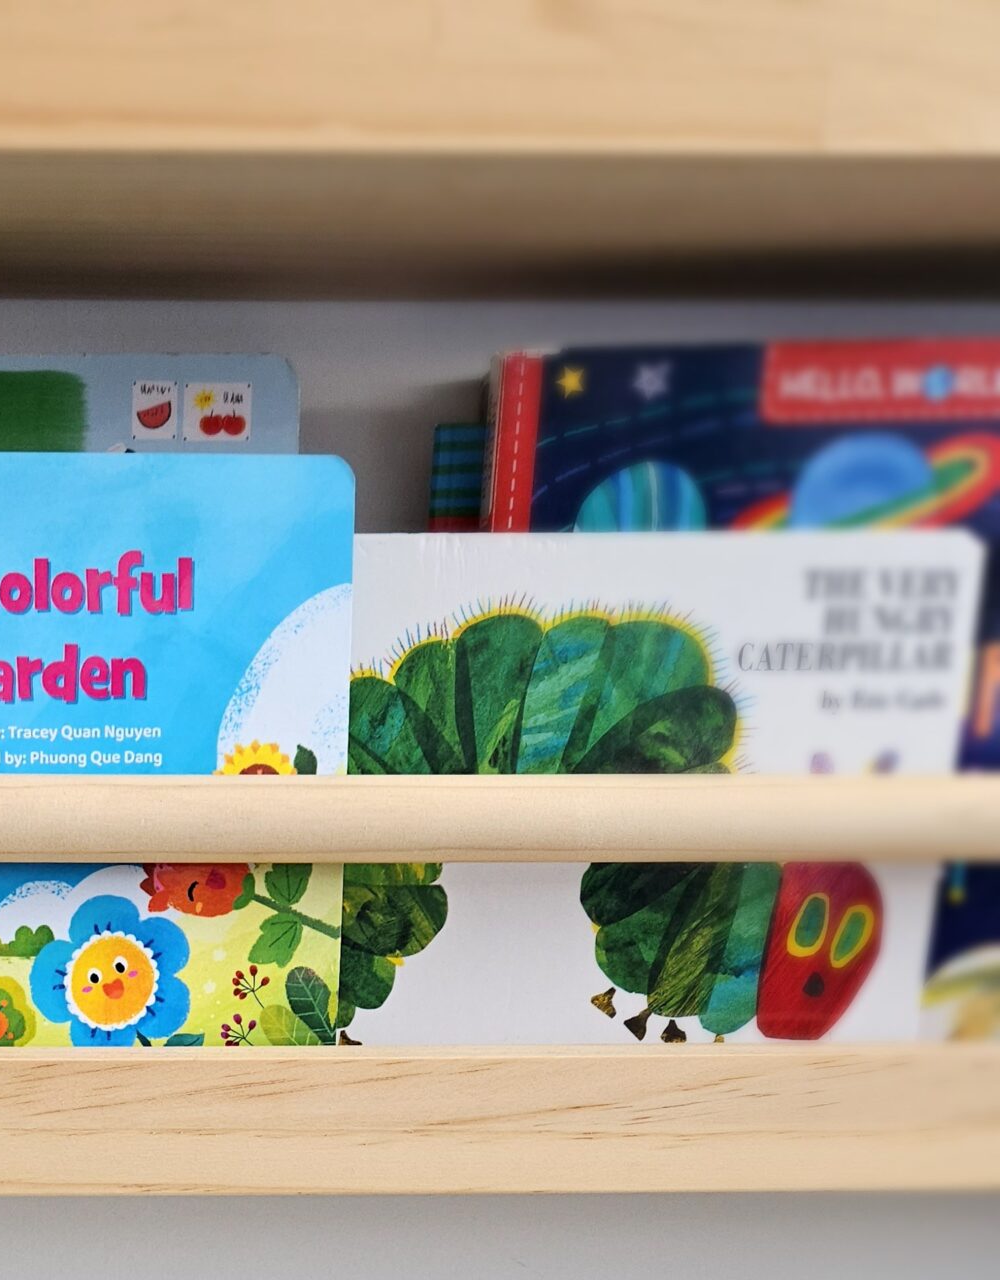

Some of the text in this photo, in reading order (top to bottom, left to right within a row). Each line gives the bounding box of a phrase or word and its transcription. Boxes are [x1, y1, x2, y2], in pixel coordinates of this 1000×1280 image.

[737, 641, 953, 673] CATERPILLAR
[8, 725, 58, 742] Tracey
[61, 725, 101, 740] Quan
[104, 724, 161, 740] Nguyen
[4, 751, 26, 766] by:
[29, 750, 88, 768] Phuong
[89, 750, 121, 766] Que
[123, 750, 163, 768] Dang
